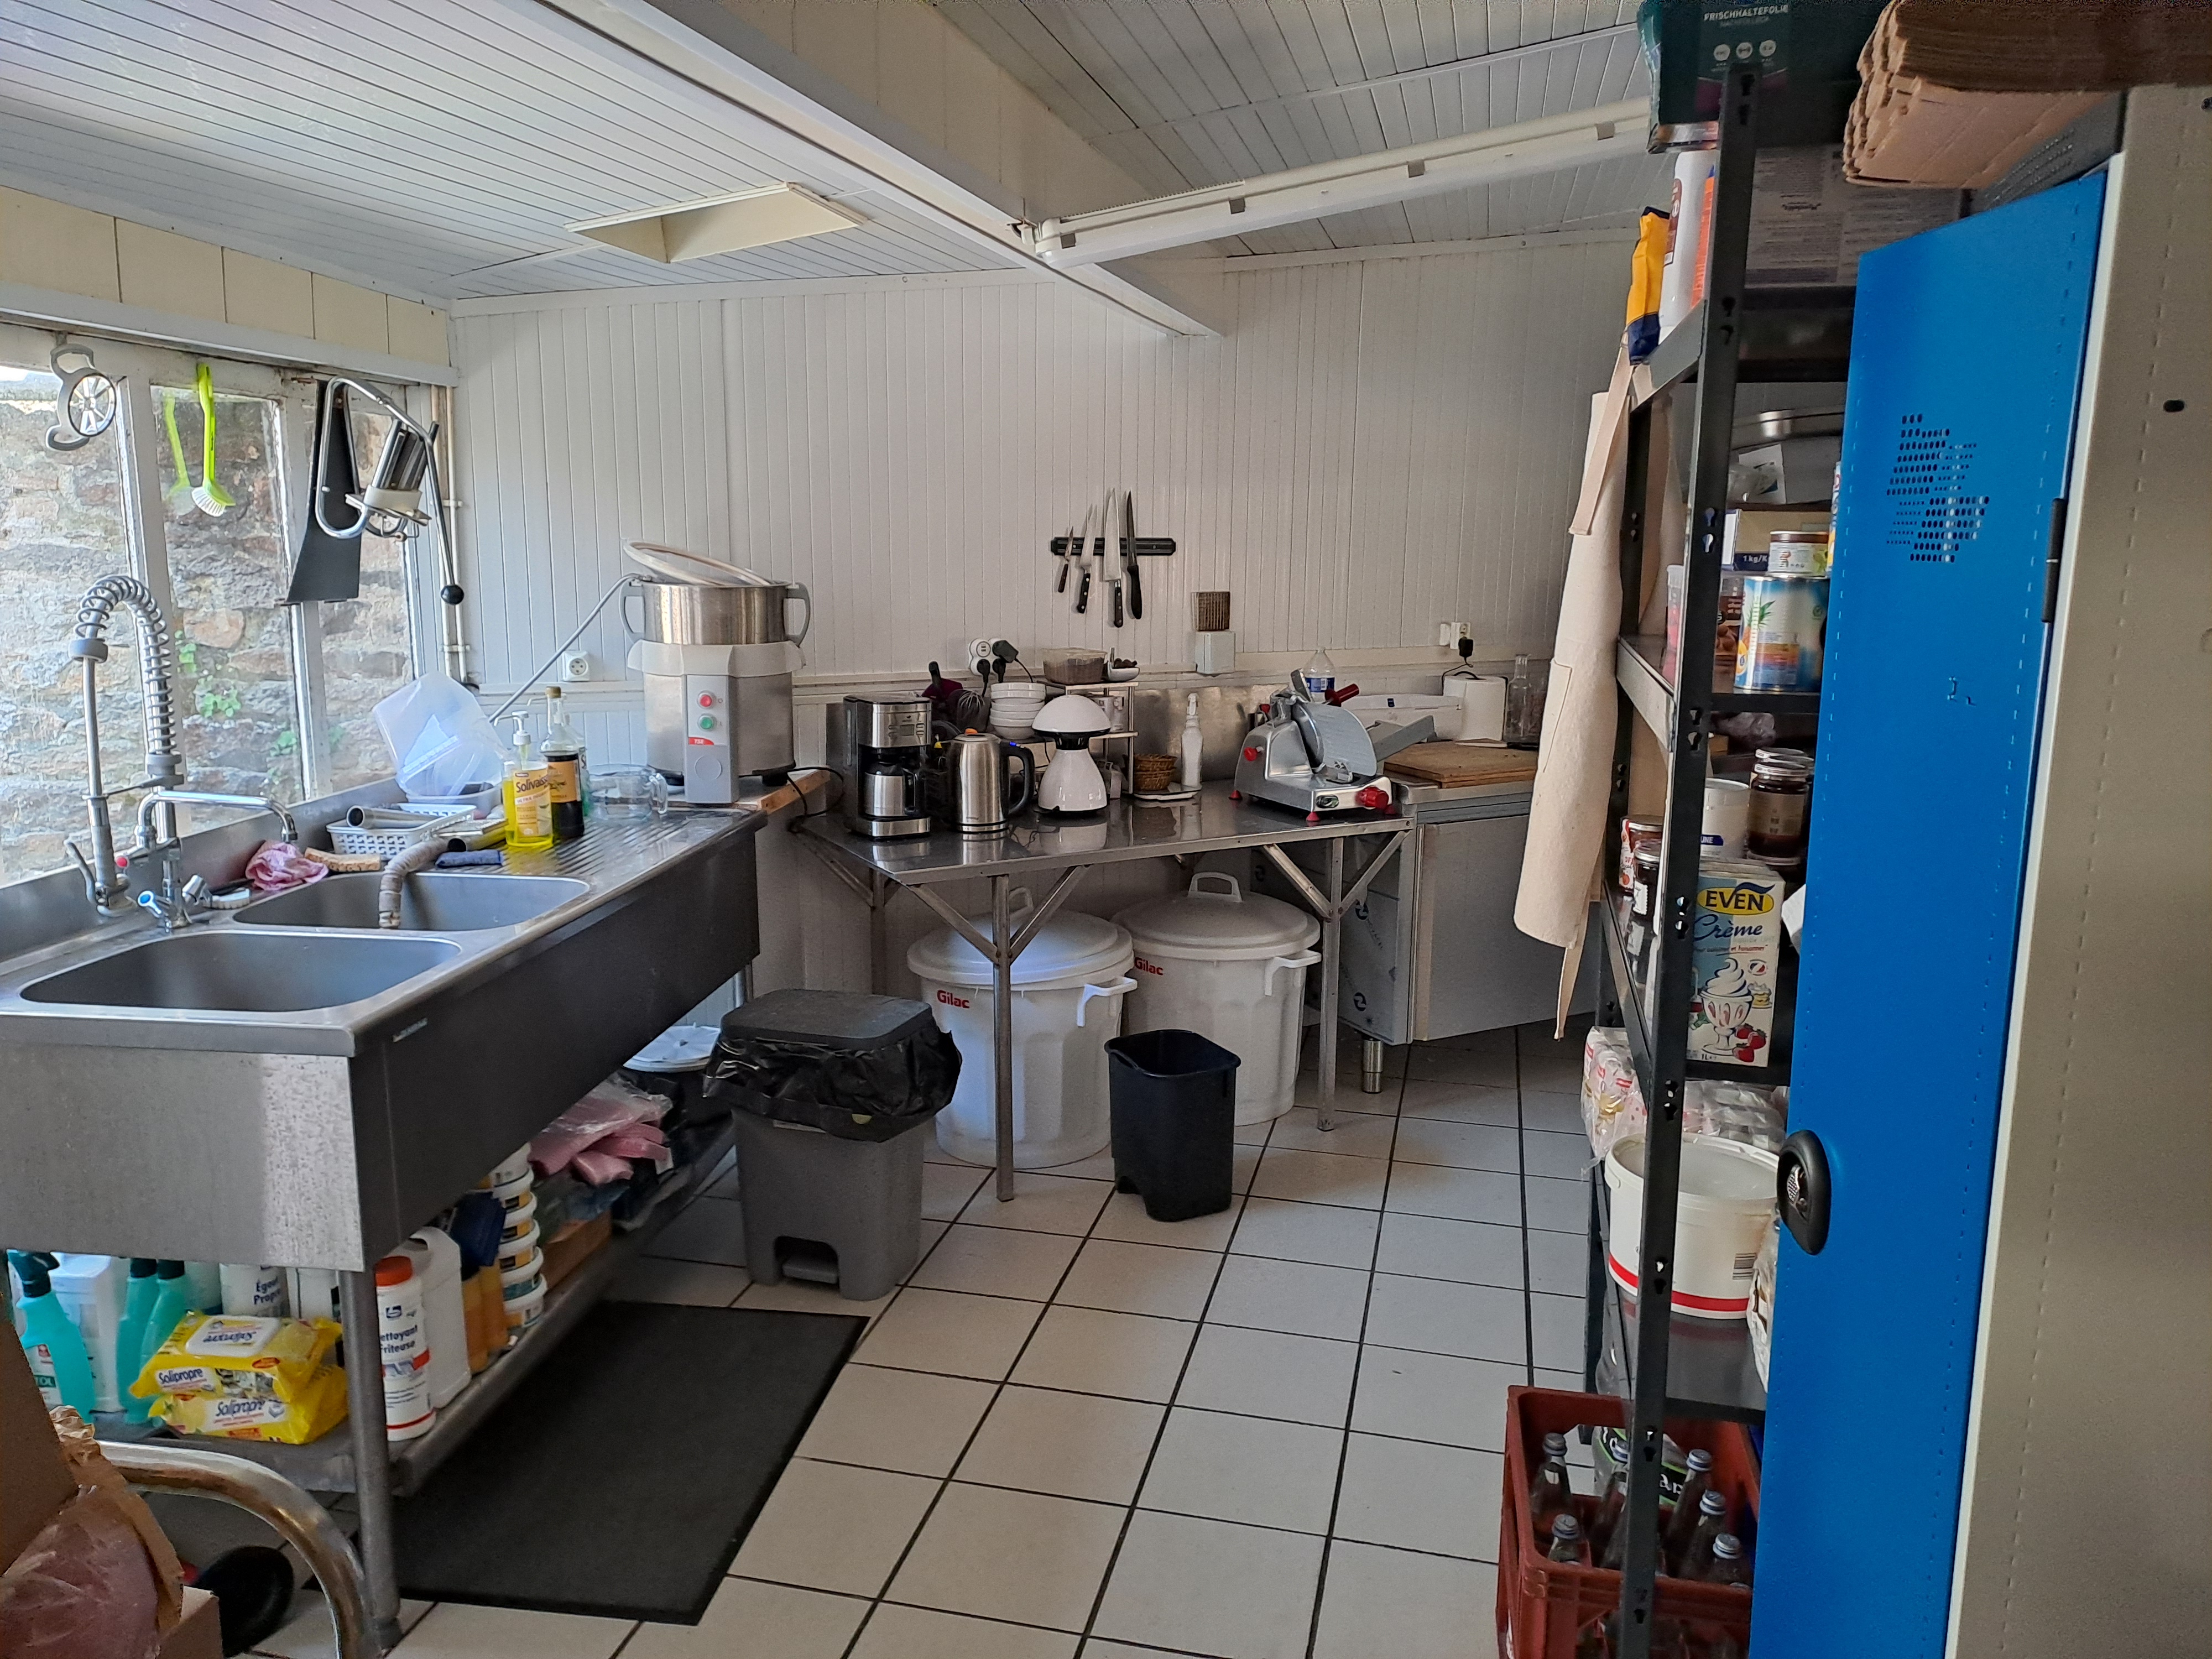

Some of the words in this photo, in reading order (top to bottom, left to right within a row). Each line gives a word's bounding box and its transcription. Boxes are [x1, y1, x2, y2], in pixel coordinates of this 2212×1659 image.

[1705, 890, 1765, 911] EVEN
[1693, 914, 1764, 942] Crème
[1134, 956, 1165, 976] Gilac
[936, 989, 970, 1009] Gilac
[380, 1325, 418, 1342] ettoyant
[158, 1368, 204, 1384] Solipropre
